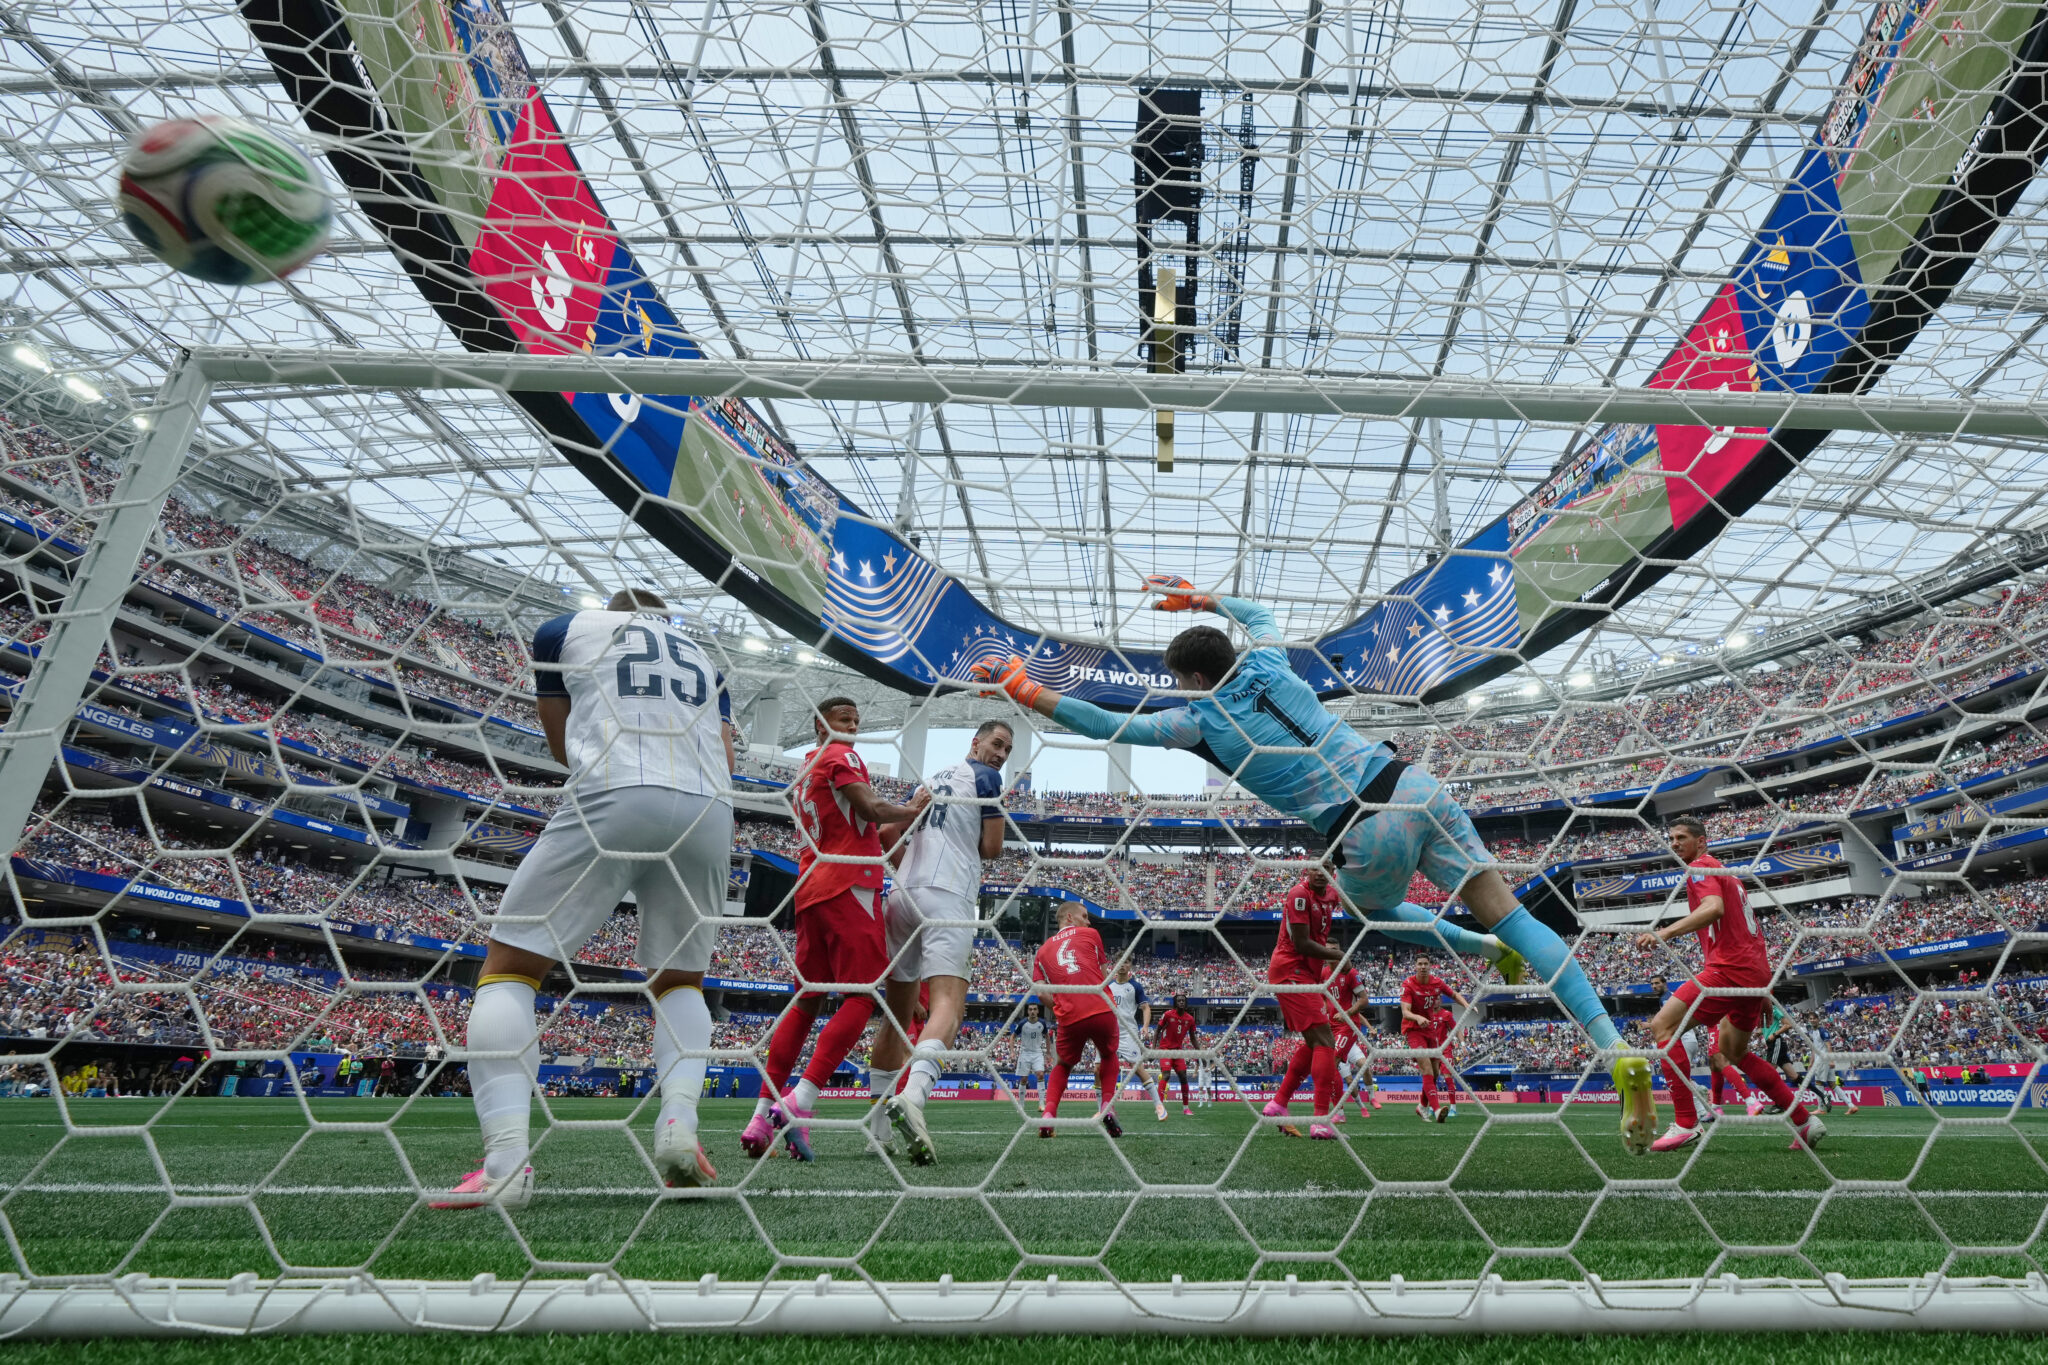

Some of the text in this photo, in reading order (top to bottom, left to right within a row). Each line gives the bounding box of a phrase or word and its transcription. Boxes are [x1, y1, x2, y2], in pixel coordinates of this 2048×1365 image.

[531, 240, 575, 332] 3
[1773, 290, 1812, 369] 0
[1581, 578, 1610, 603] Hisense
[612, 624, 710, 711] 25
[1069, 664, 1105, 684] FIFA
[1109, 671, 1173, 688] WORLD
[77, 705, 155, 740] NGELES
[1253, 687, 1319, 747] 1
[1642, 877, 1665, 889] FIFA
[145, 886, 174, 900] WORLD
[175, 892, 192, 903] CUP
[192, 896, 221, 909] 2026
[175, 952, 201, 967] FIFA
[267, 964, 303, 979] 202
[1056, 938, 1081, 975] 4
[733, 981, 754, 989] WORLD
[1335, 1033, 1349, 1049] 10
[2008, 1064, 2018, 1075] 3
[839, 1090, 855, 1098] CUP
[930, 1090, 959, 1098] PITALITY
[1958, 1089, 1978, 1102] CUP
[1978, 1089, 2016, 1103] 2026
